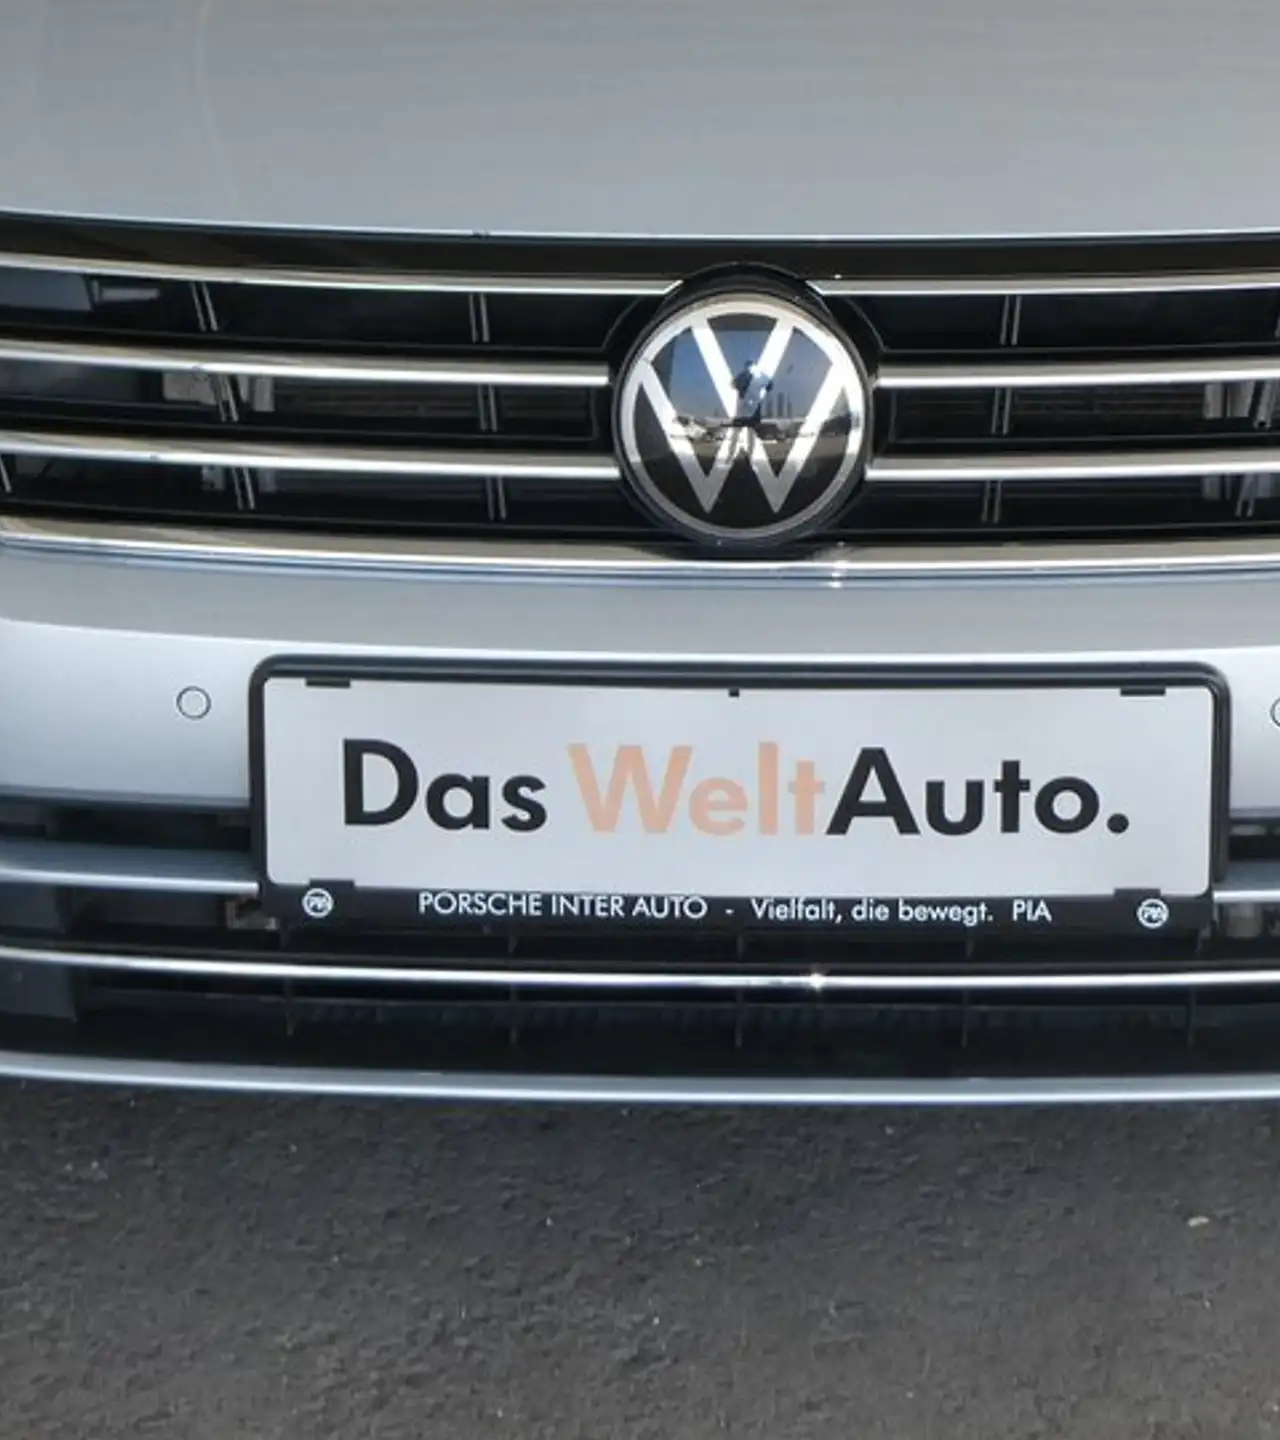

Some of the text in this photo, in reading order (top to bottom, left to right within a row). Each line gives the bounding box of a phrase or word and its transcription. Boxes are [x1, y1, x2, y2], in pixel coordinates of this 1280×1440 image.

[342, 738, 1130, 837] Das WeltAuto.
[418, 891, 543, 916] PORSCHE
[551, 893, 625, 917] INTER
[631, 895, 708, 919] AUTO
[751, 897, 843, 924] Vielfalt,
[851, 897, 890, 921] die
[897, 898, 994, 927] bewegt.
[1012, 898, 1053, 922] PIA
